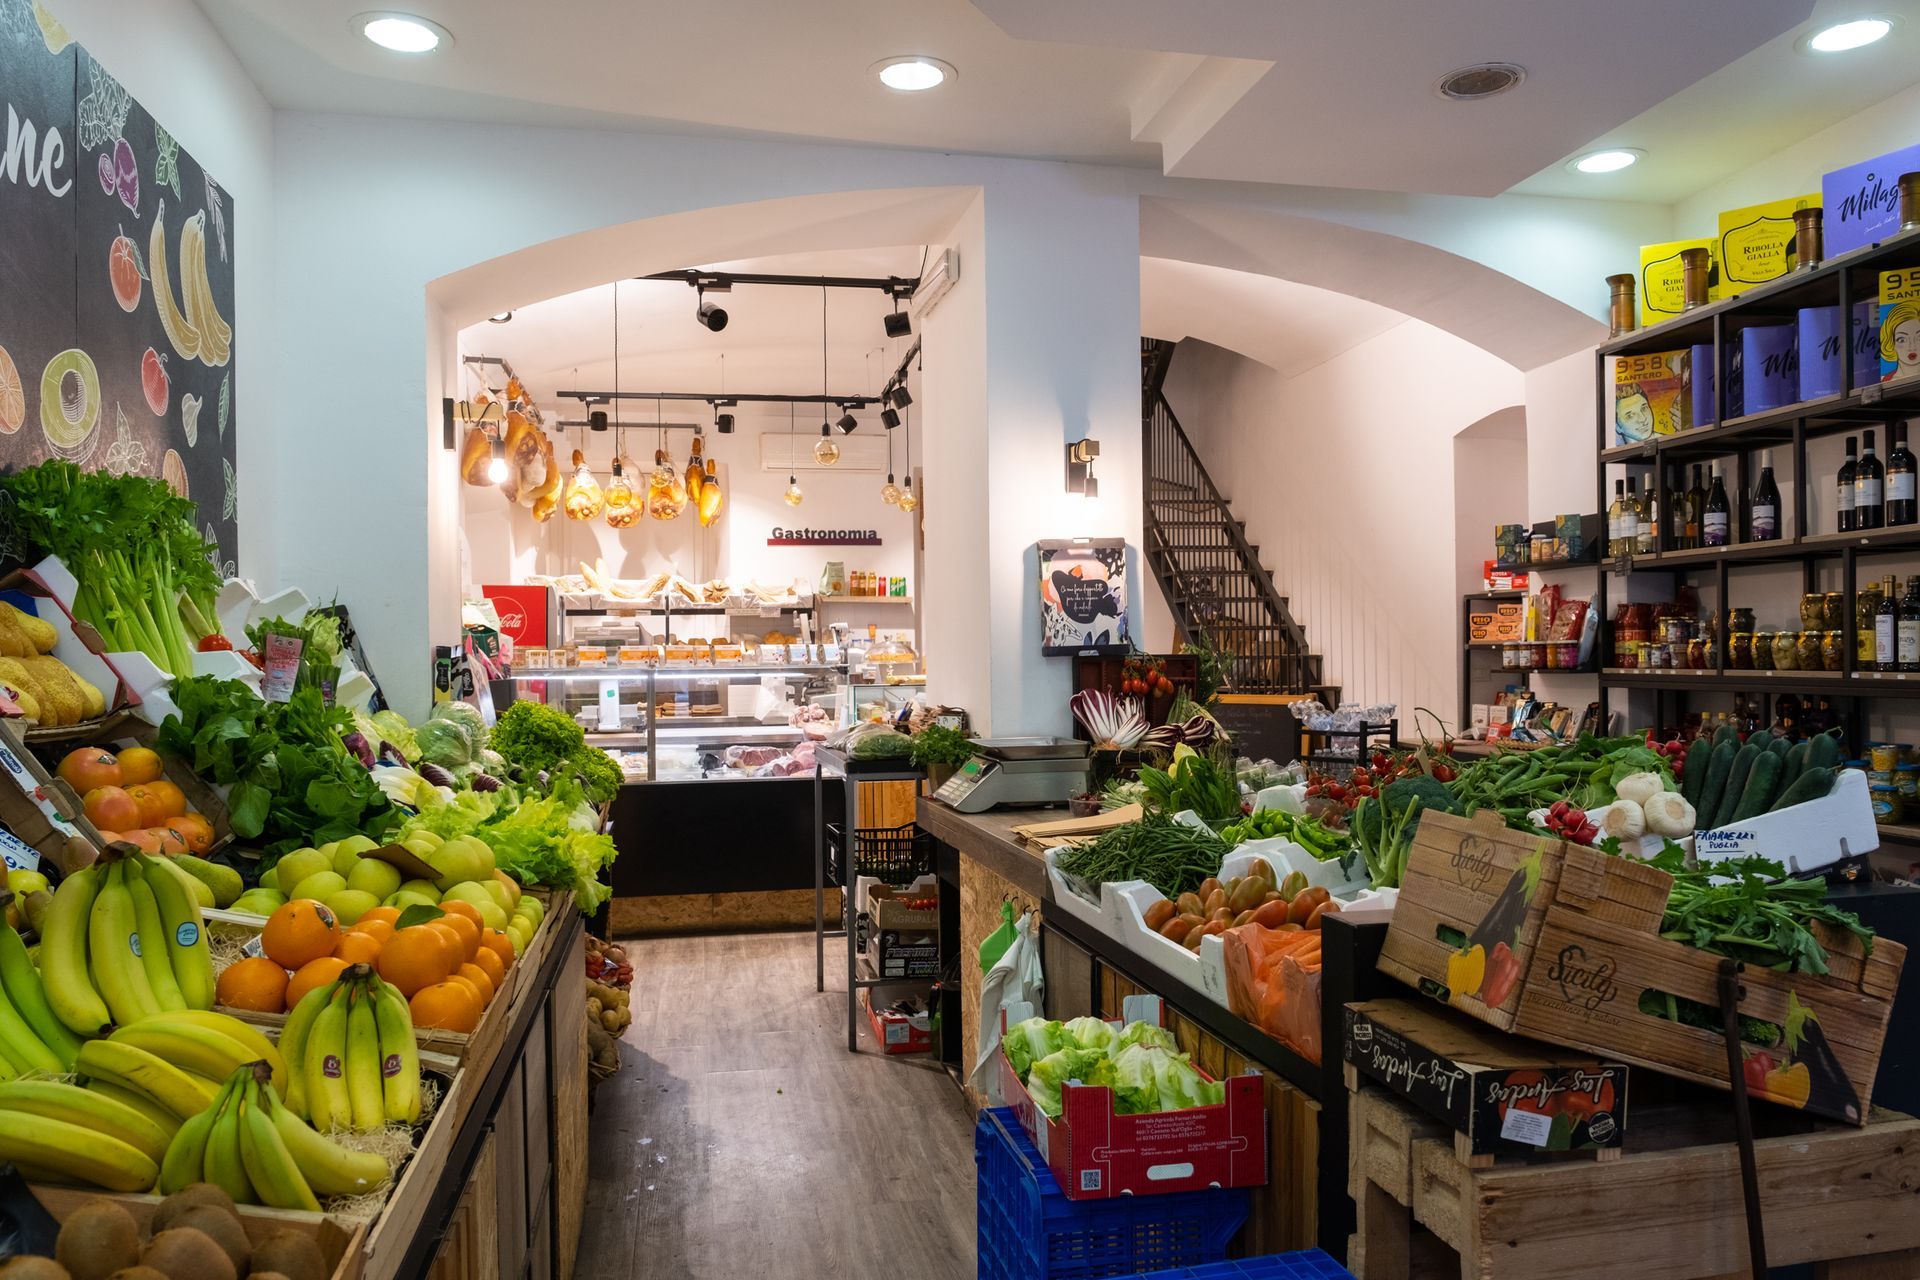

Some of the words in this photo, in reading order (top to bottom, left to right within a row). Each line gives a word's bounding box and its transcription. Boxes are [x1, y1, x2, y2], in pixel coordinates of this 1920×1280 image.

[1743, 241, 1784, 254] RIBOLLA
[1747, 250, 1780, 261] GIALLA
[1617, 372, 1662, 382] SANTERO
[772, 527, 877, 539] Gastronomia
[1709, 841, 1739, 849] PUGLIA
[1548, 947, 1618, 1010] Sicily
[1372, 1045, 1428, 1092] Andas
[1427, 1059, 1464, 1110] Las
[1485, 1076, 1569, 1109] Andas
[1571, 1070, 1614, 1103] Las
